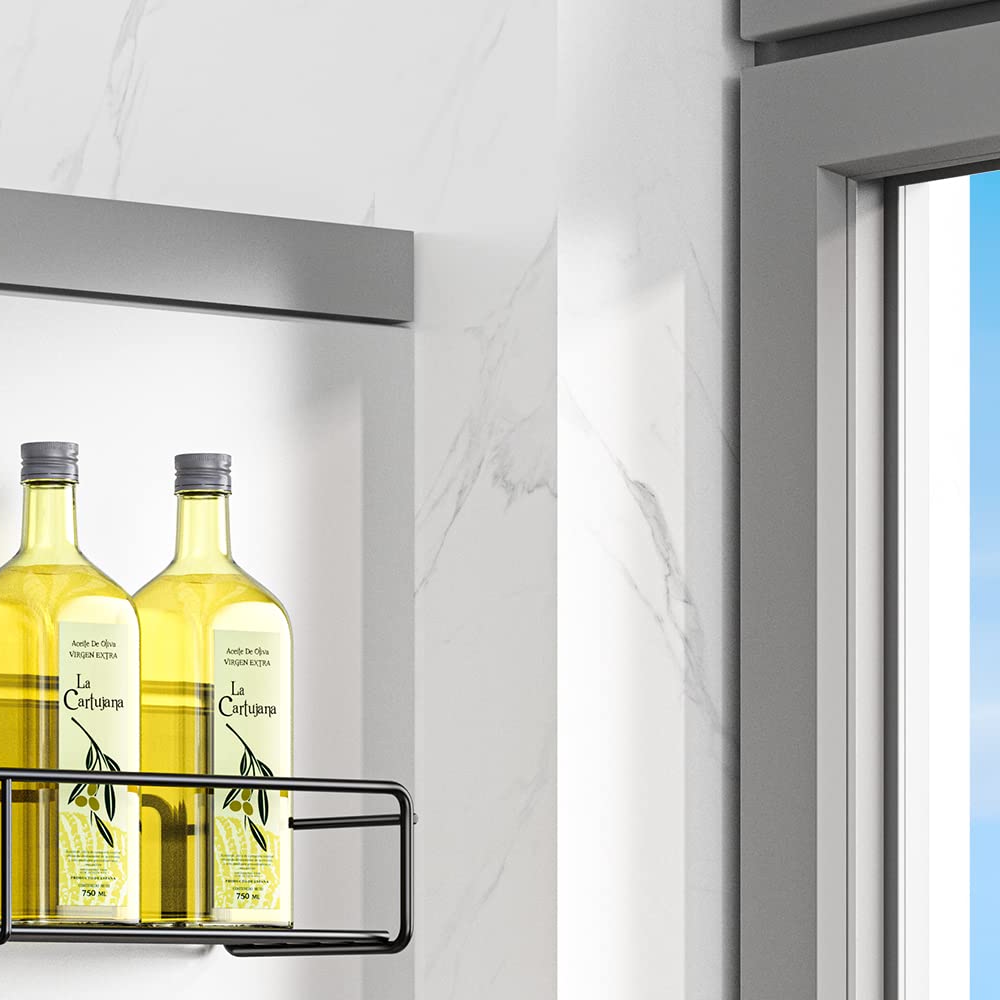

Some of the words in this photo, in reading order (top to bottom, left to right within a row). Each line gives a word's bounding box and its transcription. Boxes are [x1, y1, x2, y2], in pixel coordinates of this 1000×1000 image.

[69, 651, 95, 660] VIRGEN
[95, 652, 118, 660] EXTRA
[224, 658, 248, 667] VIRGEN
[249, 659, 271, 667] EXTRA
[76, 673, 91, 688] La
[231, 681, 245, 696] La
[63, 688, 124, 711] Cartujana
[218, 695, 277, 718] Cartujana
[82, 889, 96, 897] 750
[236, 892, 250, 900] 750
